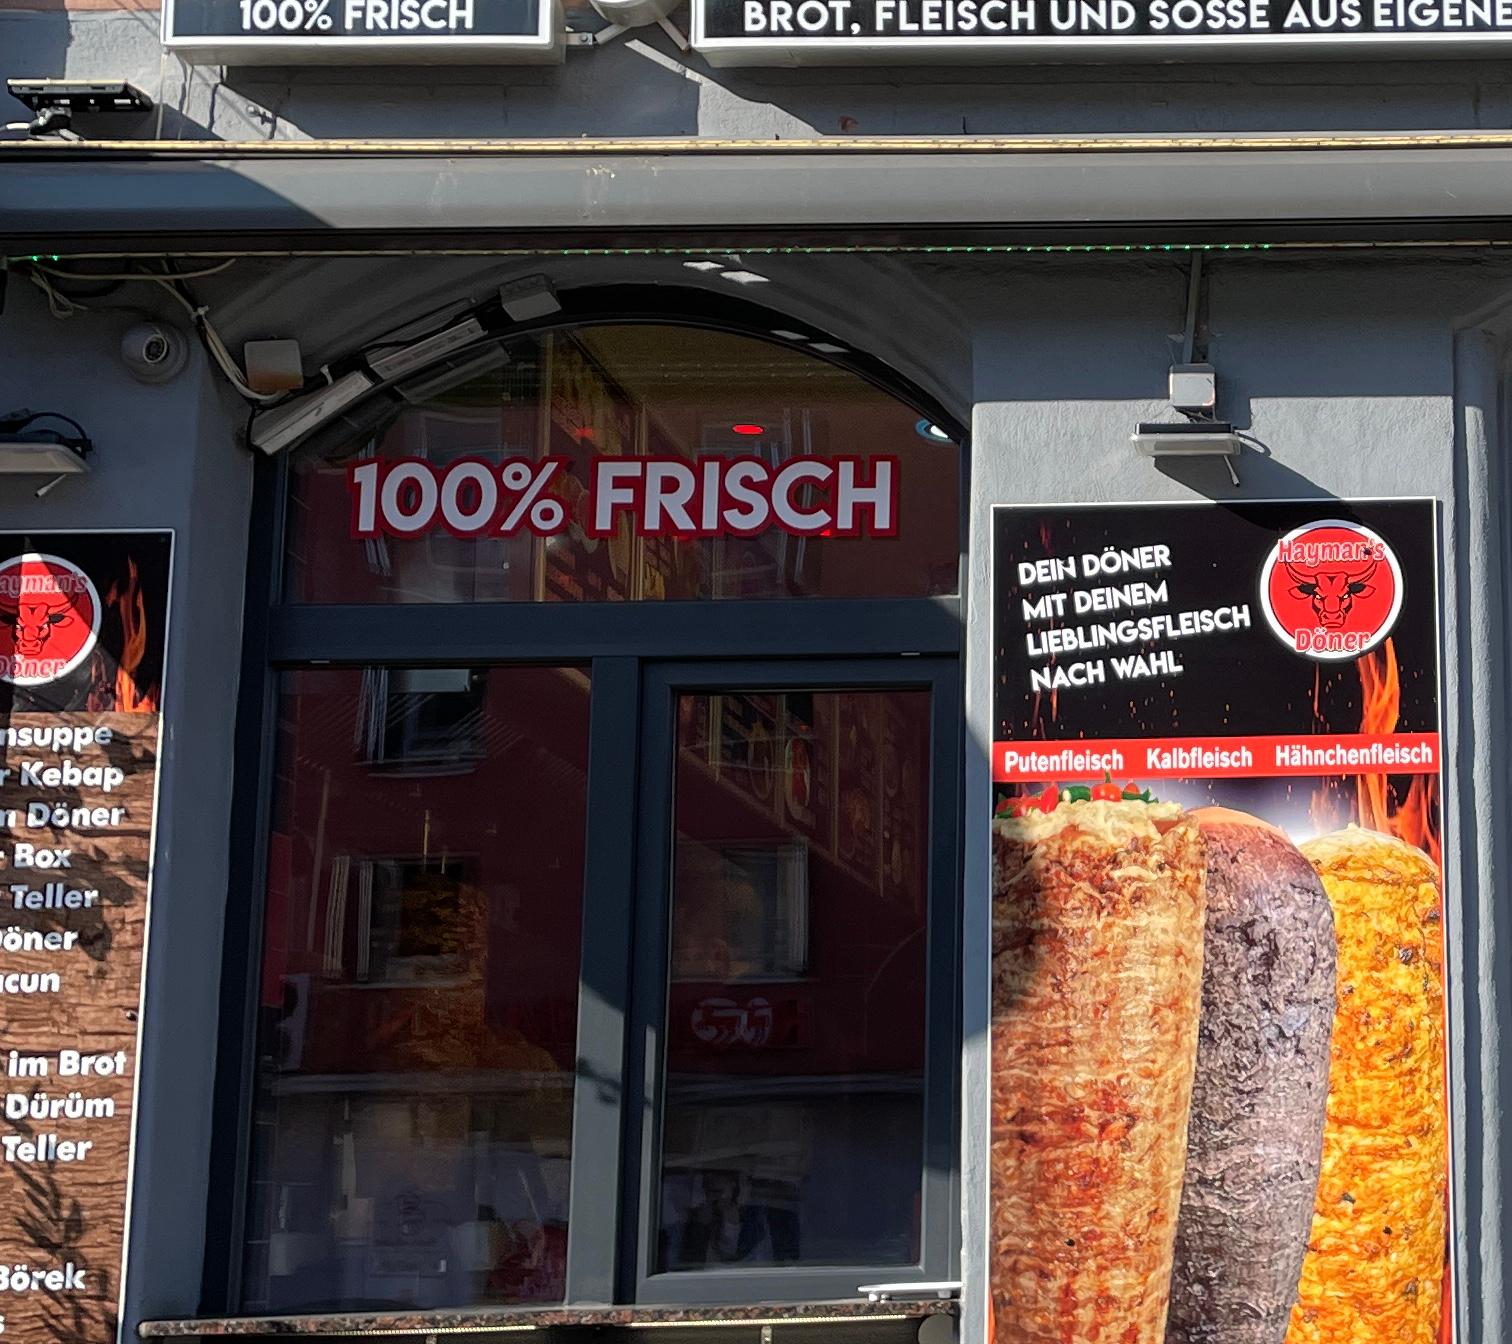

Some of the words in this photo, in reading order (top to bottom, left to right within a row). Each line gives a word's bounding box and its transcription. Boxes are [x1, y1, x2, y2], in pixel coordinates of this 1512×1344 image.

[743, 0, 861, 34] BROT,
[875, 0, 1036, 32] FLEISCH
[352, 460, 565, 532] 100%
[595, 460, 892, 531] FRISCH
[1018, 556, 1077, 586] DEIN
[1081, 544, 1173, 578] DÖNER
[1277, 537, 1386, 566] Hayman's
[1022, 592, 1068, 621] MIT
[1072, 580, 1168, 613] DEINEM
[1025, 604, 1251, 656] LIEBLINGSFLEISCH
[1295, 626, 1372, 652] Döner
[1029, 659, 1105, 692] NACH
[1110, 650, 1184, 681] WAHL
[1004, 749, 1124, 774] Putenfleisch
[1146, 746, 1253, 771] Kalbfleisch
[1275, 742, 1433, 768] Hähnchenfleisch
[20, 759, 125, 793] Kebap
[27, 801, 126, 828] Döner
[14, 842, 72, 869] Box
[10, 882, 99, 910] Teller
[0, 925, 79, 953] öner
[8, 1050, 49, 1077] im
[58, 1049, 127, 1076] Brot
[5, 1091, 115, 1119] Dürüm
[2, 1133, 94, 1162] Teller
